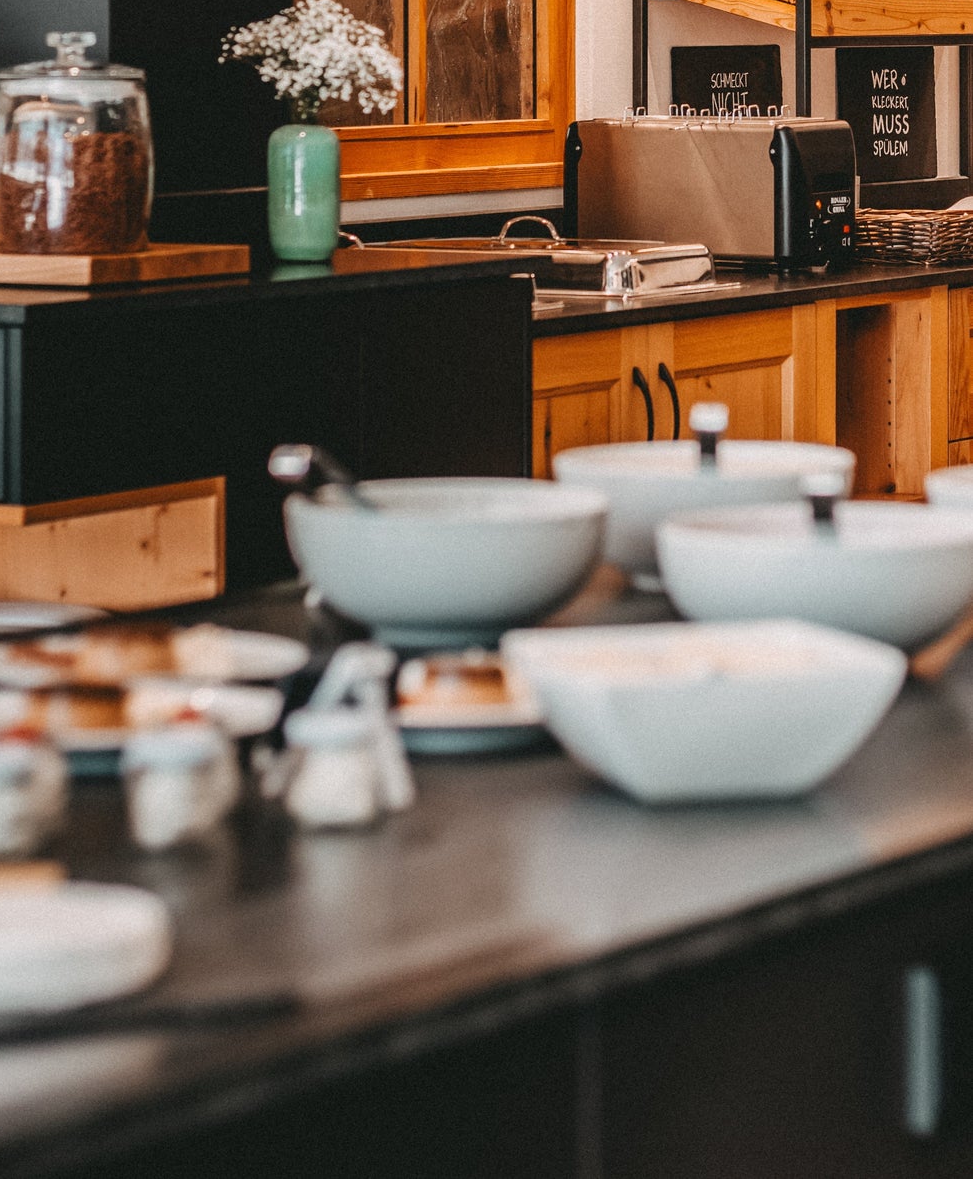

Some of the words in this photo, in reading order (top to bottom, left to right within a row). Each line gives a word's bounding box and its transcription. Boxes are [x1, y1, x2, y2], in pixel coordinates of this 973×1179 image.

[710, 72, 749, 89] SCHMECKT
[871, 69, 899, 90] WER
[711, 91, 749, 116] NICHT
[871, 95, 909, 111] KLECKERT,
[872, 113, 910, 135] MUSS
[873, 138, 909, 157] SPÜLEN!
